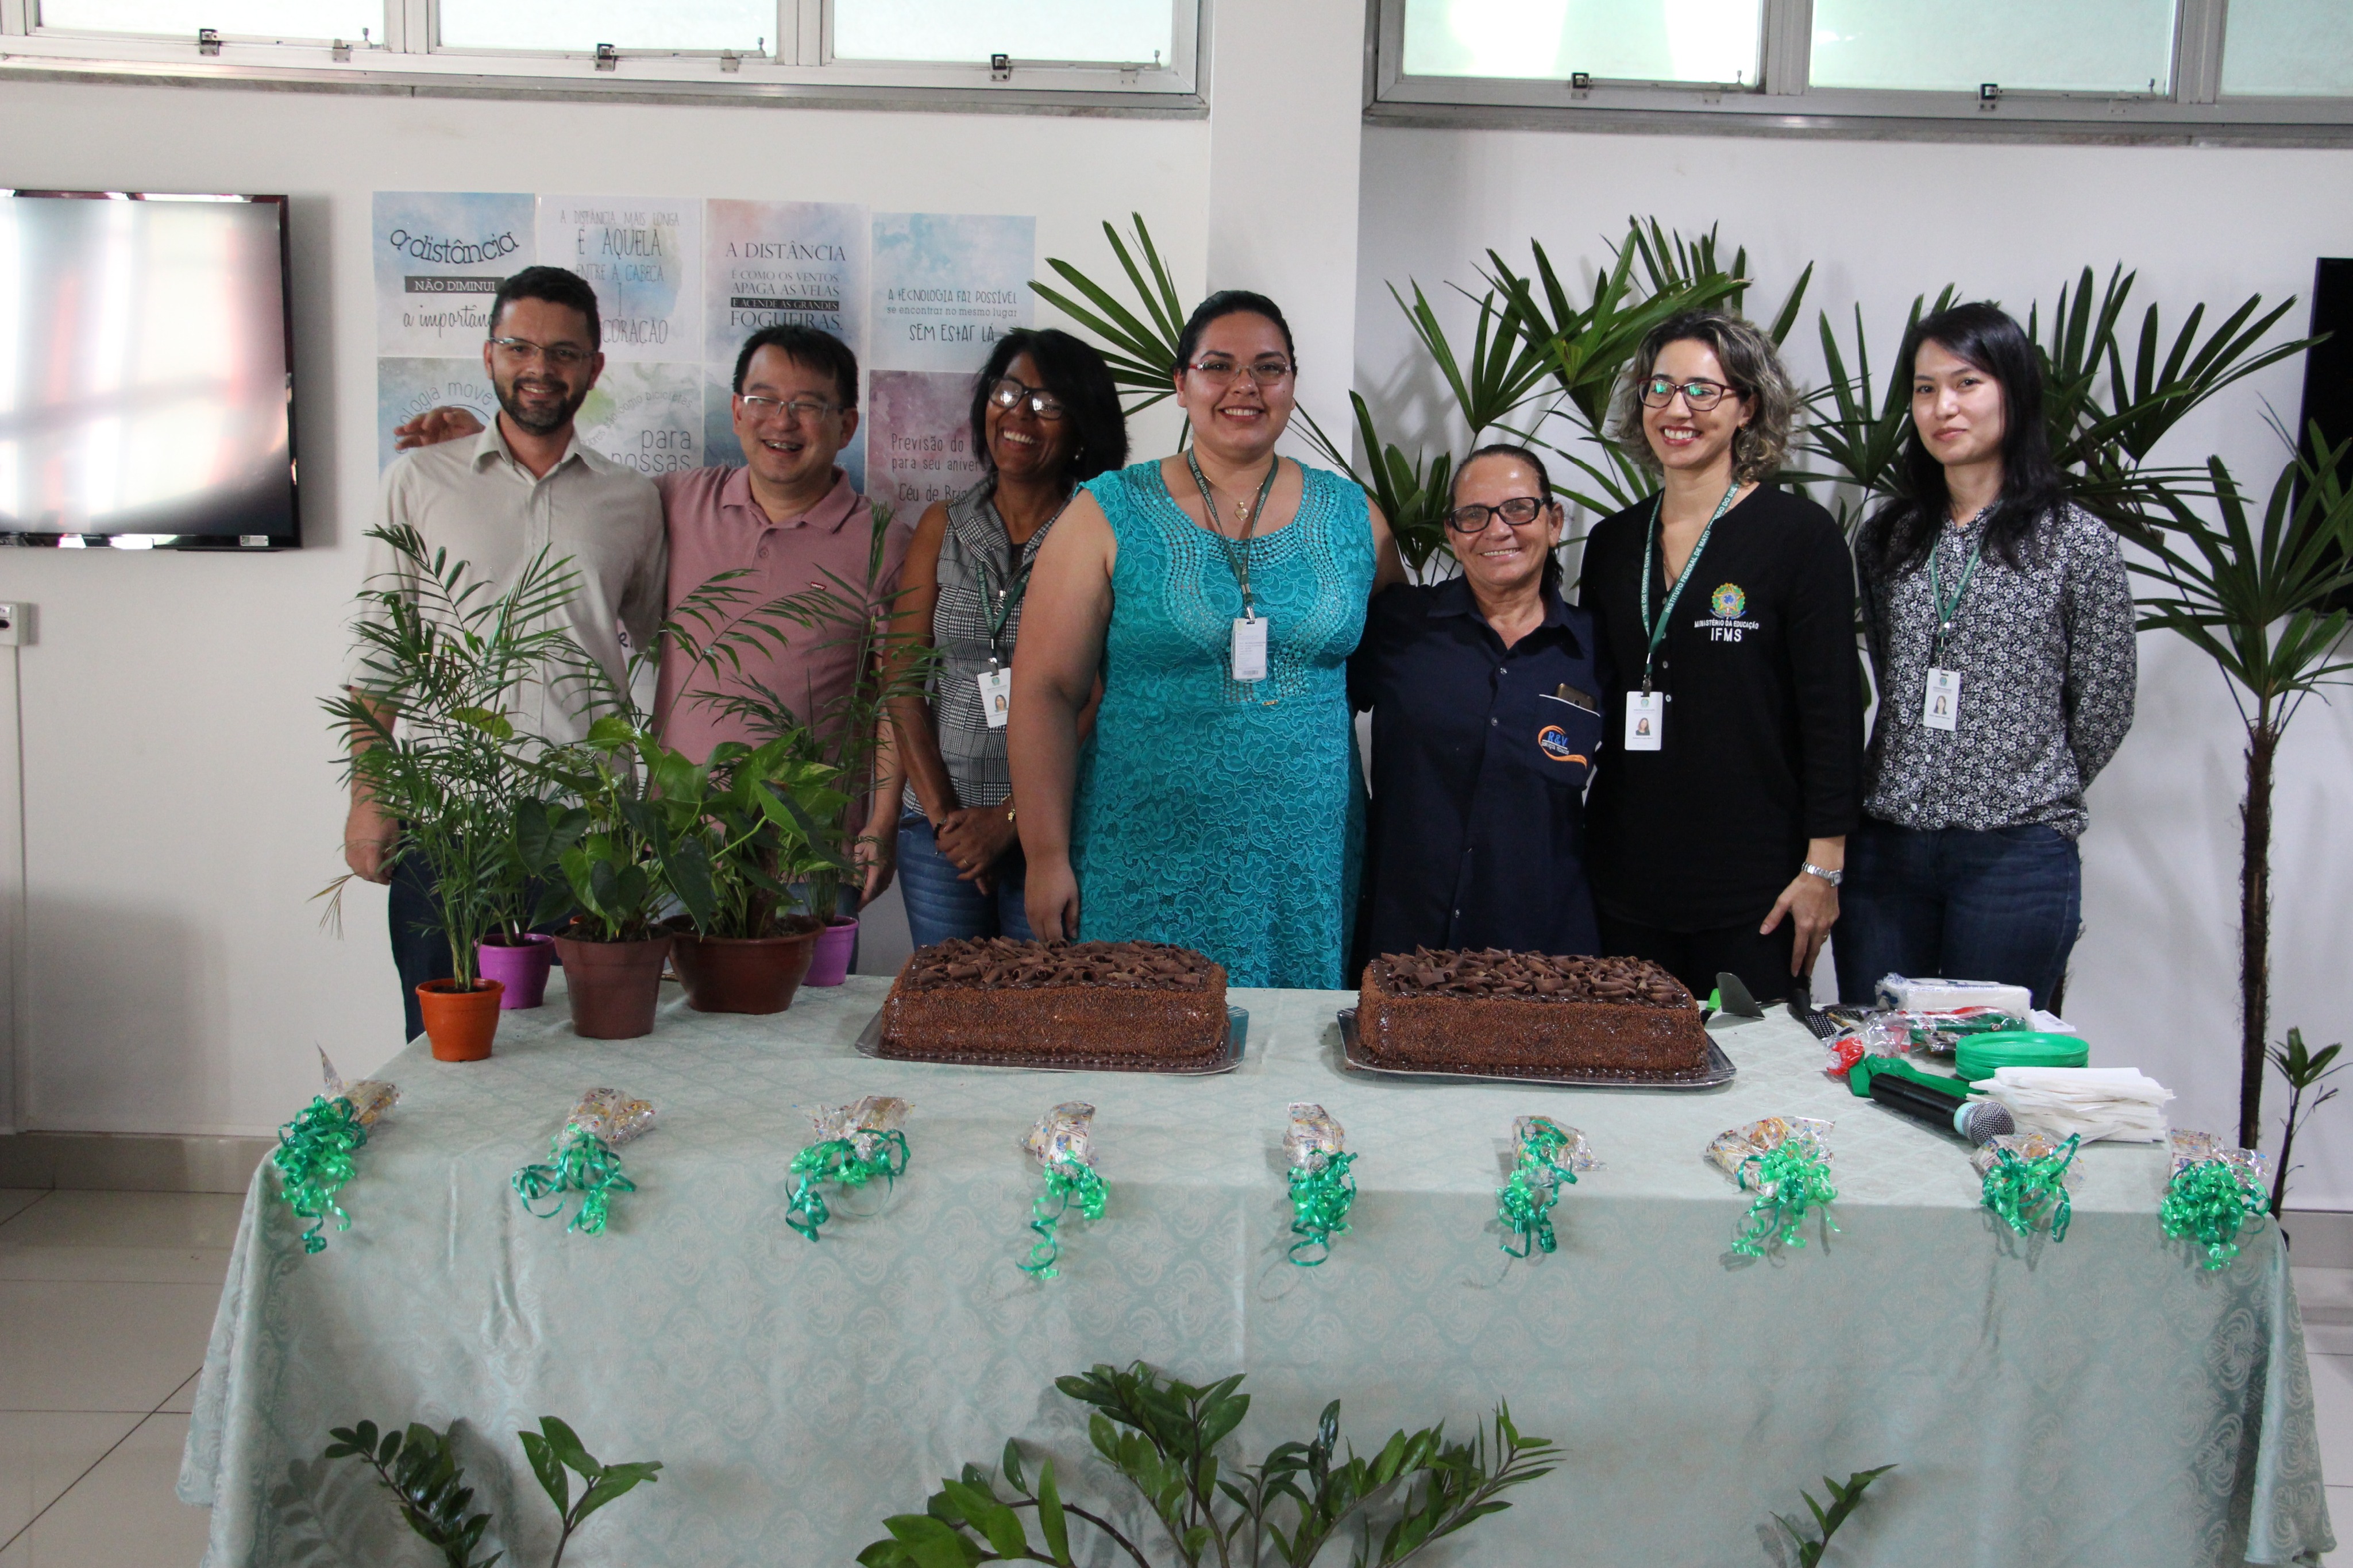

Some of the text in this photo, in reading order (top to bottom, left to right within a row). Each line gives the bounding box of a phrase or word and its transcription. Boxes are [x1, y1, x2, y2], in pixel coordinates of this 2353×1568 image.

[560, 210, 566, 223] A
[624, 211, 646, 226] MAIS
[653, 213, 680, 226] LONGA
[391, 229, 519, 264] a distância
[603, 228, 662, 260] AQUELA
[726, 240, 846, 261] A DISTÂNCIA
[612, 264, 619, 280] A
[740, 271, 775, 280] COMO
[778, 272, 793, 281] OS
[797, 272, 839, 282] VENTOS
[415, 279, 496, 292] NÃO DIMINUI
[732, 283, 839, 296] APAGA AS VELAS
[742, 299, 778, 308] ACENDE
[794, 302, 838, 310] GRANDES
[888, 289, 894, 301] A
[957, 291, 971, 304] FAZ
[976, 289, 1017, 304] POSSÍVEL
[403, 313, 414, 327] a
[899, 306, 943, 315] encontrar
[959, 308, 990, 316] mesmo
[993, 308, 1017, 319] lugar
[909, 323, 935, 341] SEM
[941, 324, 975, 342] ESTAR
[448, 382, 493, 405] move
[642, 430, 691, 455] para
[892, 433, 964, 453] Previsão do
[892, 458, 916, 473] para
[923, 459, 940, 470] seu
[1195, 471, 1202, 480] DE
[899, 483, 919, 501] Céu
[926, 484, 939, 501] de
[1198, 478, 1208, 494] MATO
[1665, 582, 1684, 613] INSTITUTO
[1680, 557, 1698, 583] FEDERAL
[1694, 547, 1702, 556] DE
[1698, 530, 1711, 547] MATO
[1722, 497, 1730, 507] DO
[1727, 486, 1737, 498] SUL
[1694, 618, 1724, 628] MINISTÉRIO
[1733, 621, 1760, 630] EDUCAÇÃO
[1711, 628, 1742, 642] IFMS
[1548, 731, 1568, 747] R&V
